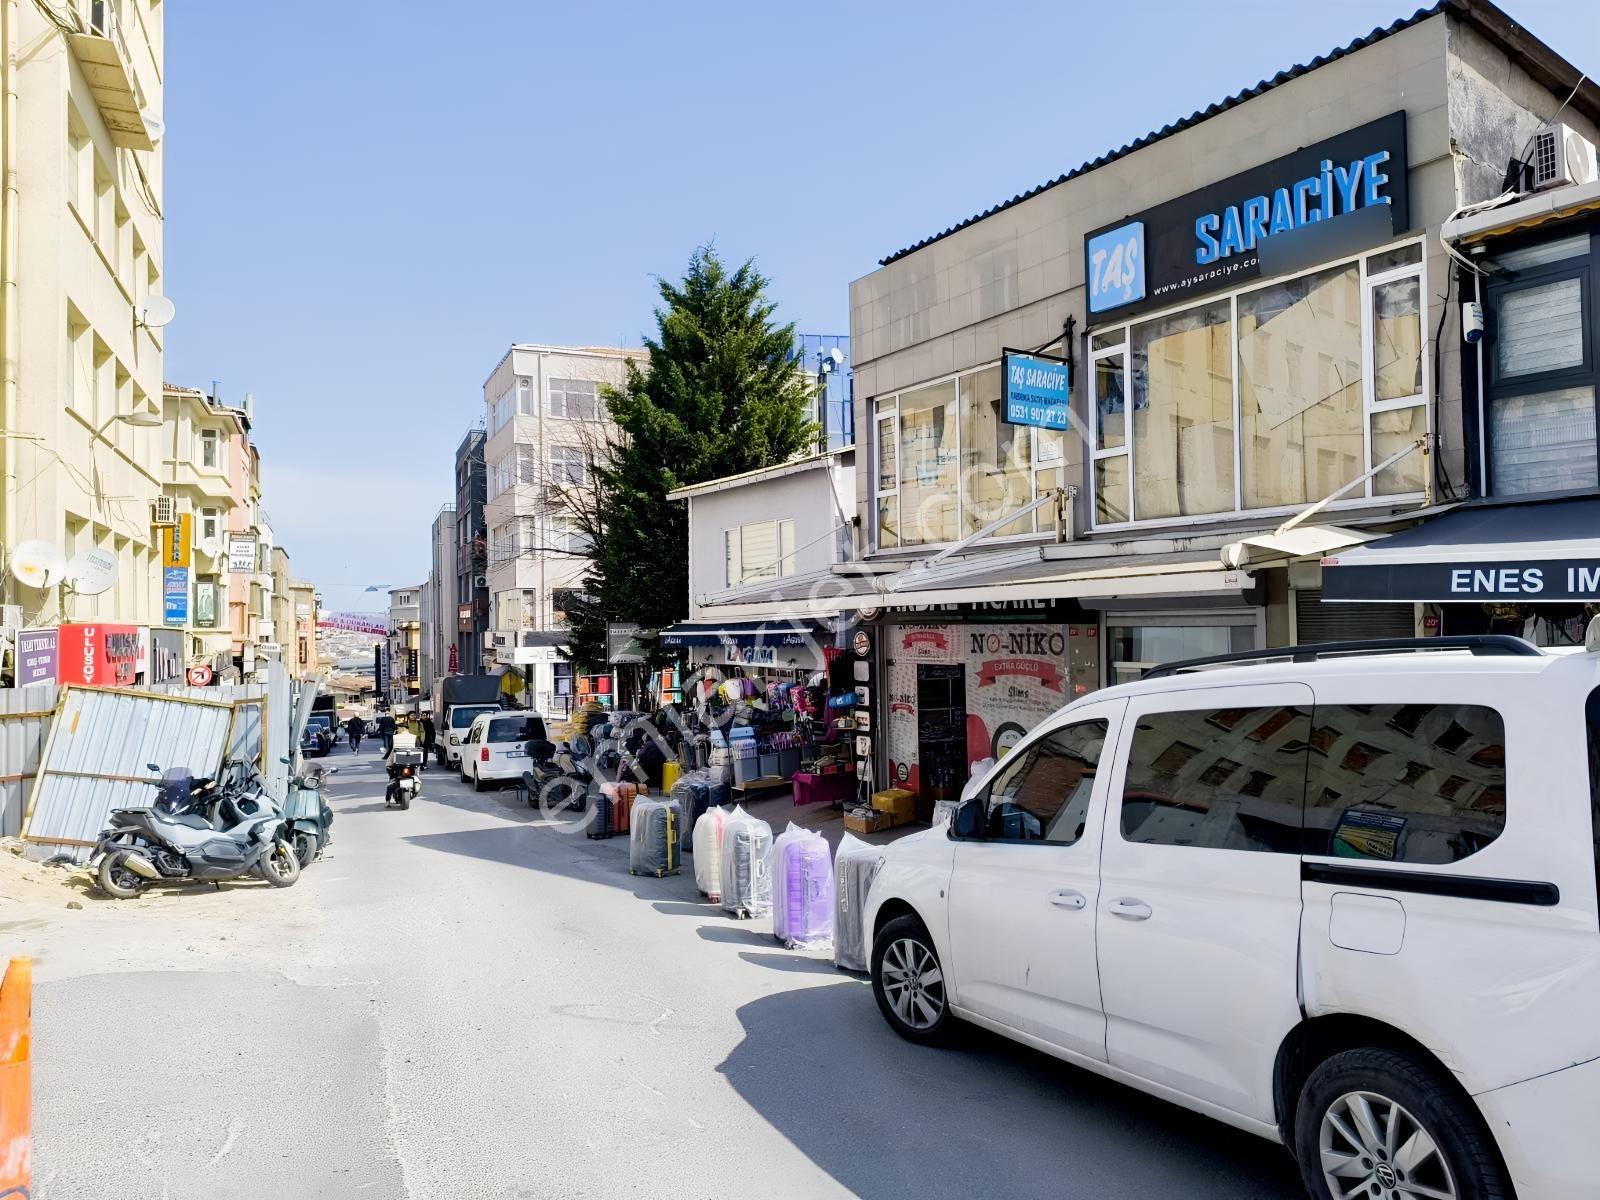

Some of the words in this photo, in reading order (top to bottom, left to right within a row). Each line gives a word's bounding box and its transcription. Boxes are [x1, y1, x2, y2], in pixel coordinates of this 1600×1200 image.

[1195, 150, 1391, 265] SARACİYE
[1092, 237, 1138, 300] TAŞ
[1153, 258, 1260, 296] www.aysaraciye.co
[1010, 366, 1025, 389] TAŞ
[1025, 368, 1066, 391] SARACİYE
[1010, 404, 1028, 419] 0531
[1031, 407, 1045, 421] 907
[1046, 409, 1056, 423] 27
[1057, 411, 1066, 425] 23
[1451, 568, 1544, 593] ENES
[83, 627, 95, 684] ULUSOY
[970, 628, 1065, 657] NO-NİKO
[994, 661, 1015, 671] EXTRA
